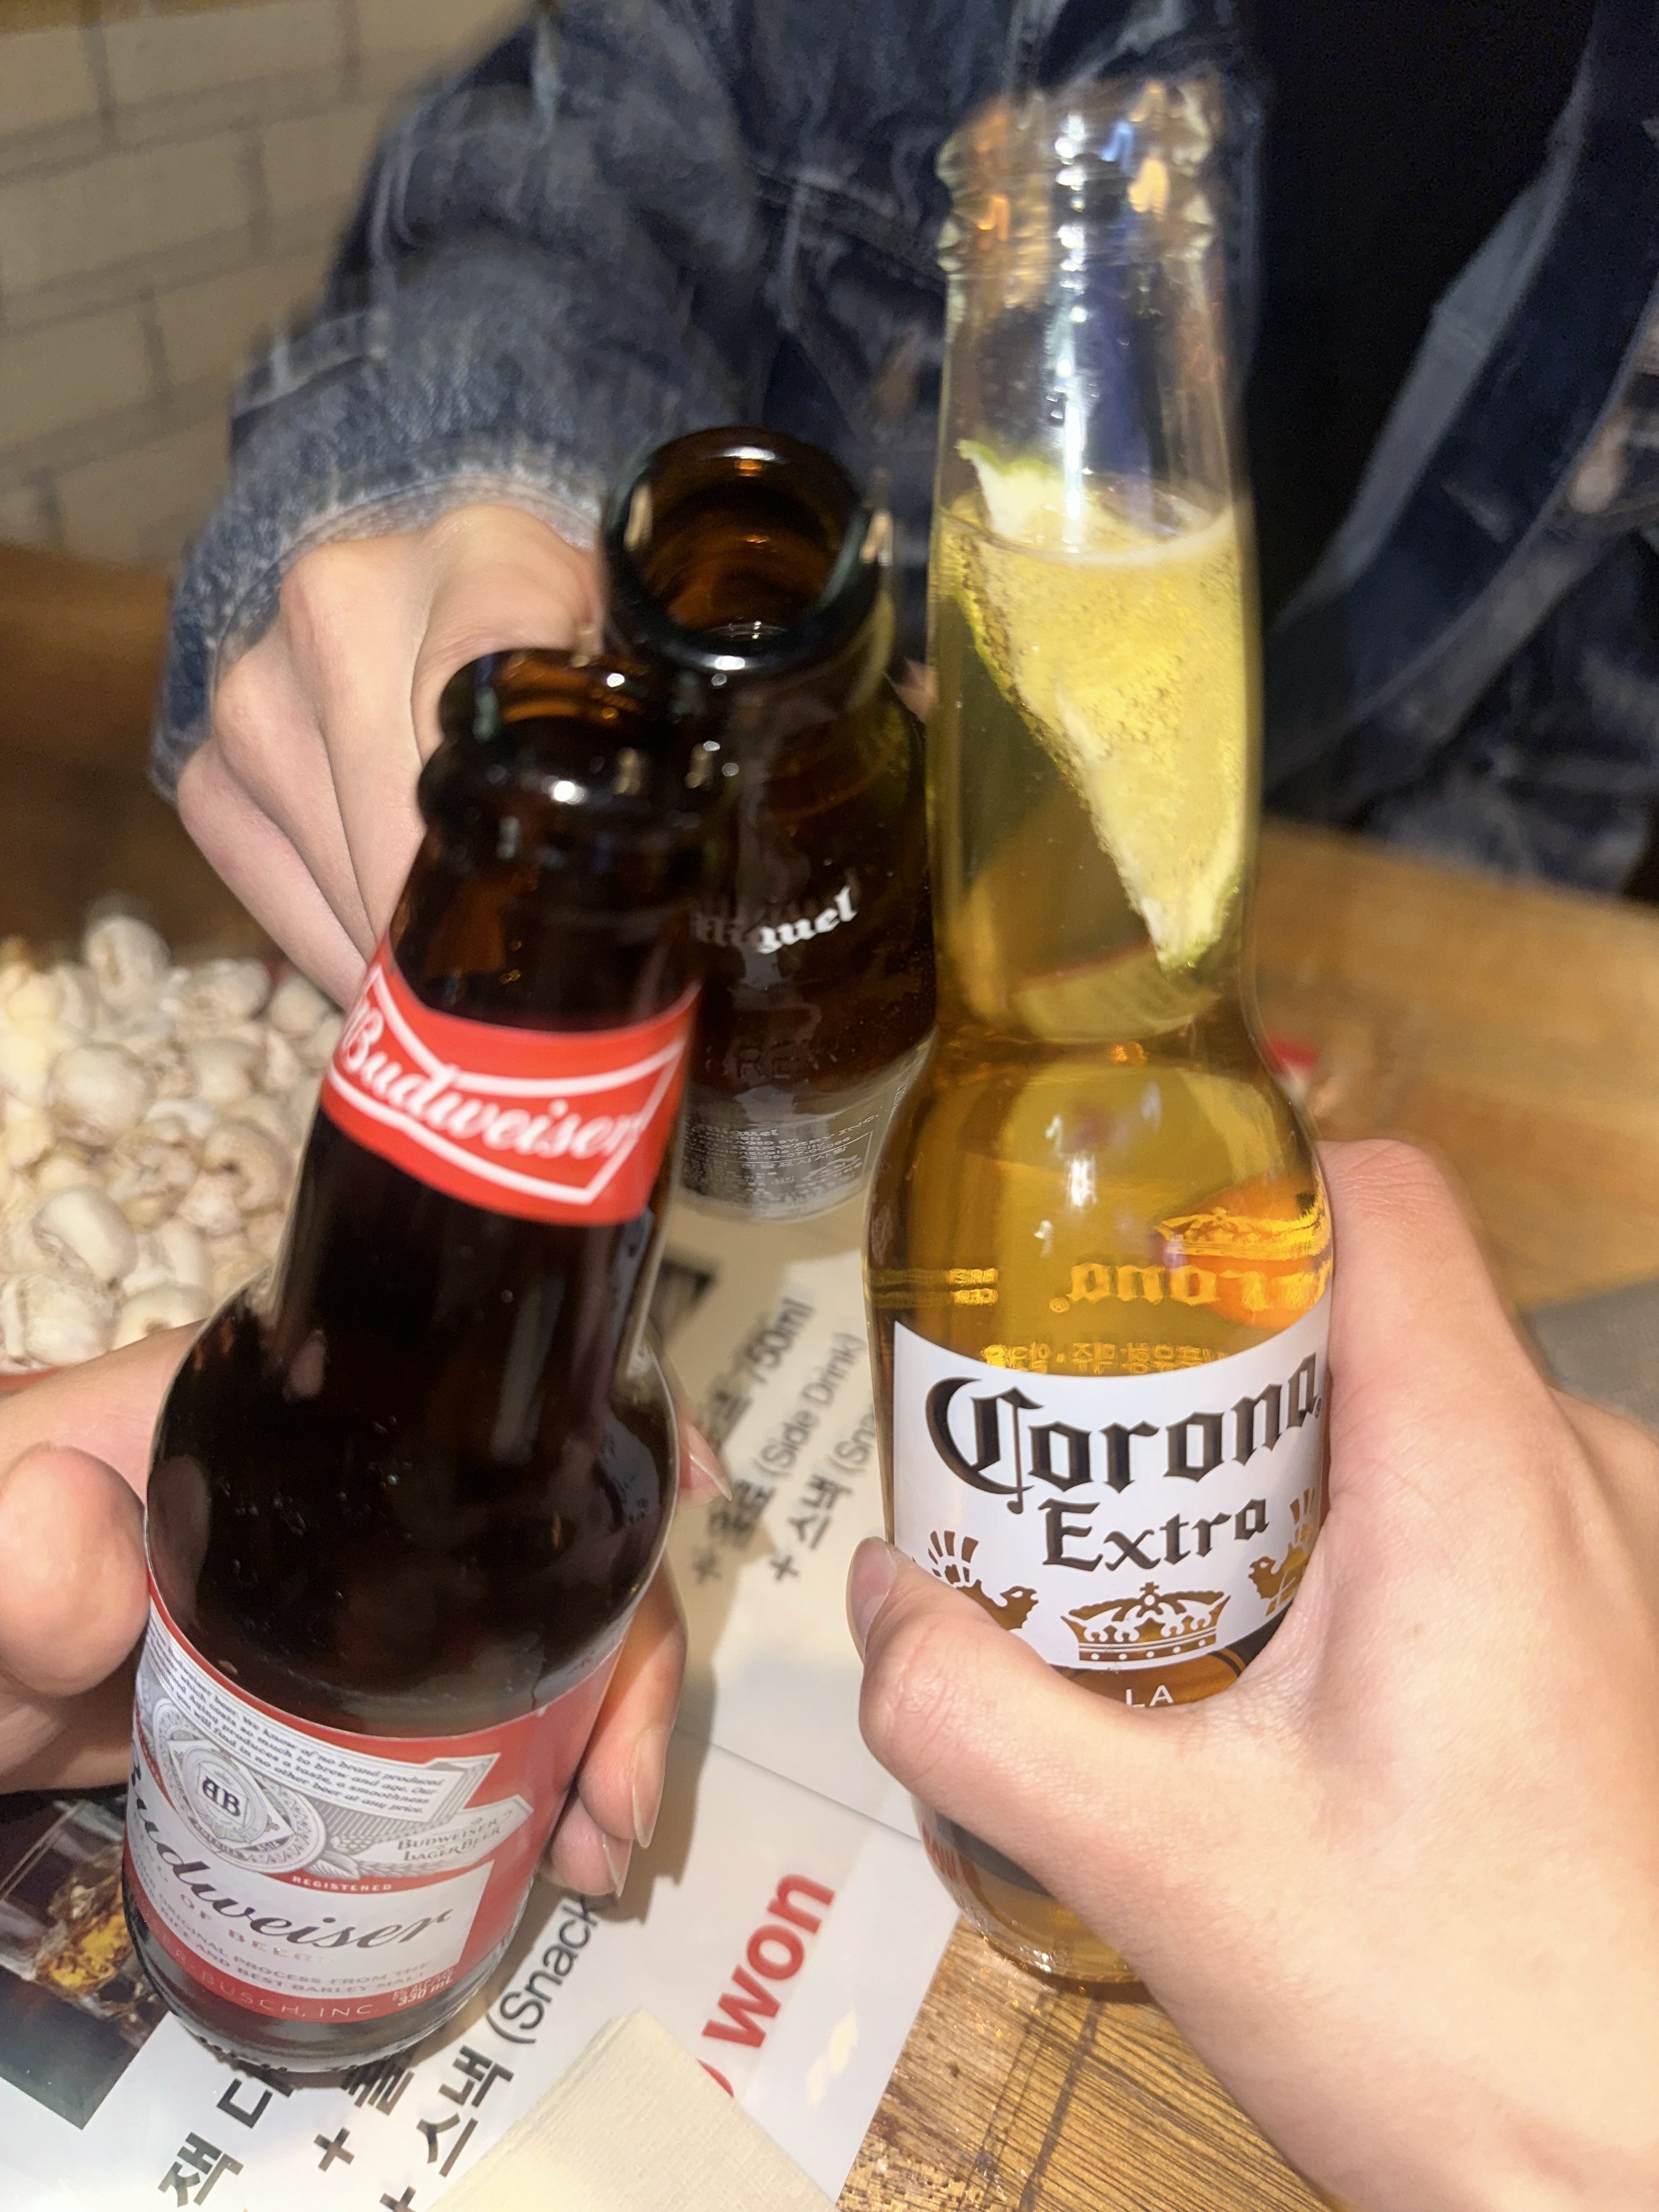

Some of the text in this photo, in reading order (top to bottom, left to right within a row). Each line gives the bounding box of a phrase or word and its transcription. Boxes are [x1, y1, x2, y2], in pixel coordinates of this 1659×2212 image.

[341, 996, 643, 1159] Budweiser
[925, 1352, 1318, 1514] Corona
[1038, 1498, 1269, 1572] Extra
[1127, 1685, 1174, 1707] LA
[291, 1874, 393, 1891] REGISTERED
[701, 1872, 836, 2049] won
[416, 2044, 515, 2178] 스낵
[157, 2131, 245, 2208] 잭
